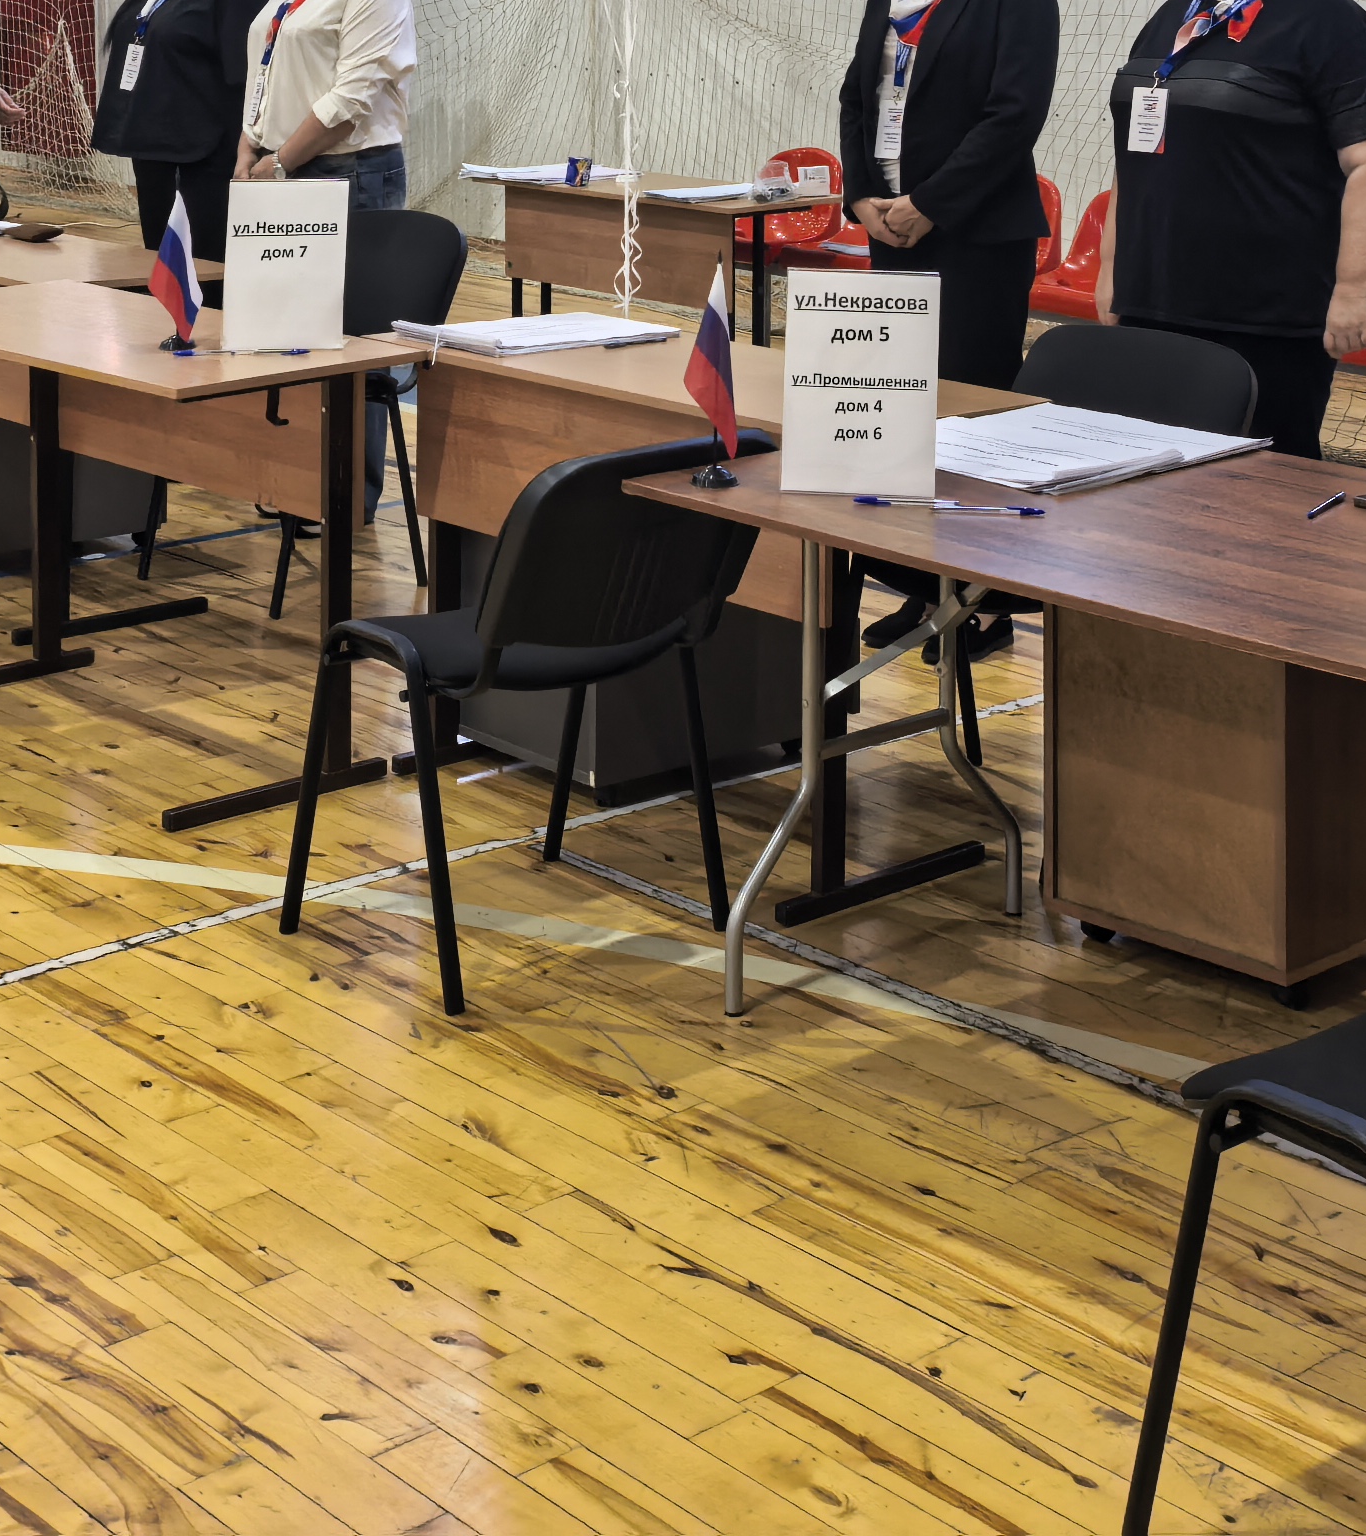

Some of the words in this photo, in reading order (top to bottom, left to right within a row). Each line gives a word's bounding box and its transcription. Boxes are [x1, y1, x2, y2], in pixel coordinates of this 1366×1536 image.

[232, 221, 338, 237] ул.Некрасова
[260, 248, 294, 261] дом
[299, 245, 308, 258] 7
[794, 292, 929, 312] ул.Некрасова
[830, 328, 873, 344] дом
[879, 326, 890, 342] 5
[791, 373, 928, 389] ул.Промышленная
[834, 401, 869, 414] дом
[873, 399, 883, 413] 4
[834, 428, 869, 442] дом
[873, 426, 883, 440] 6
